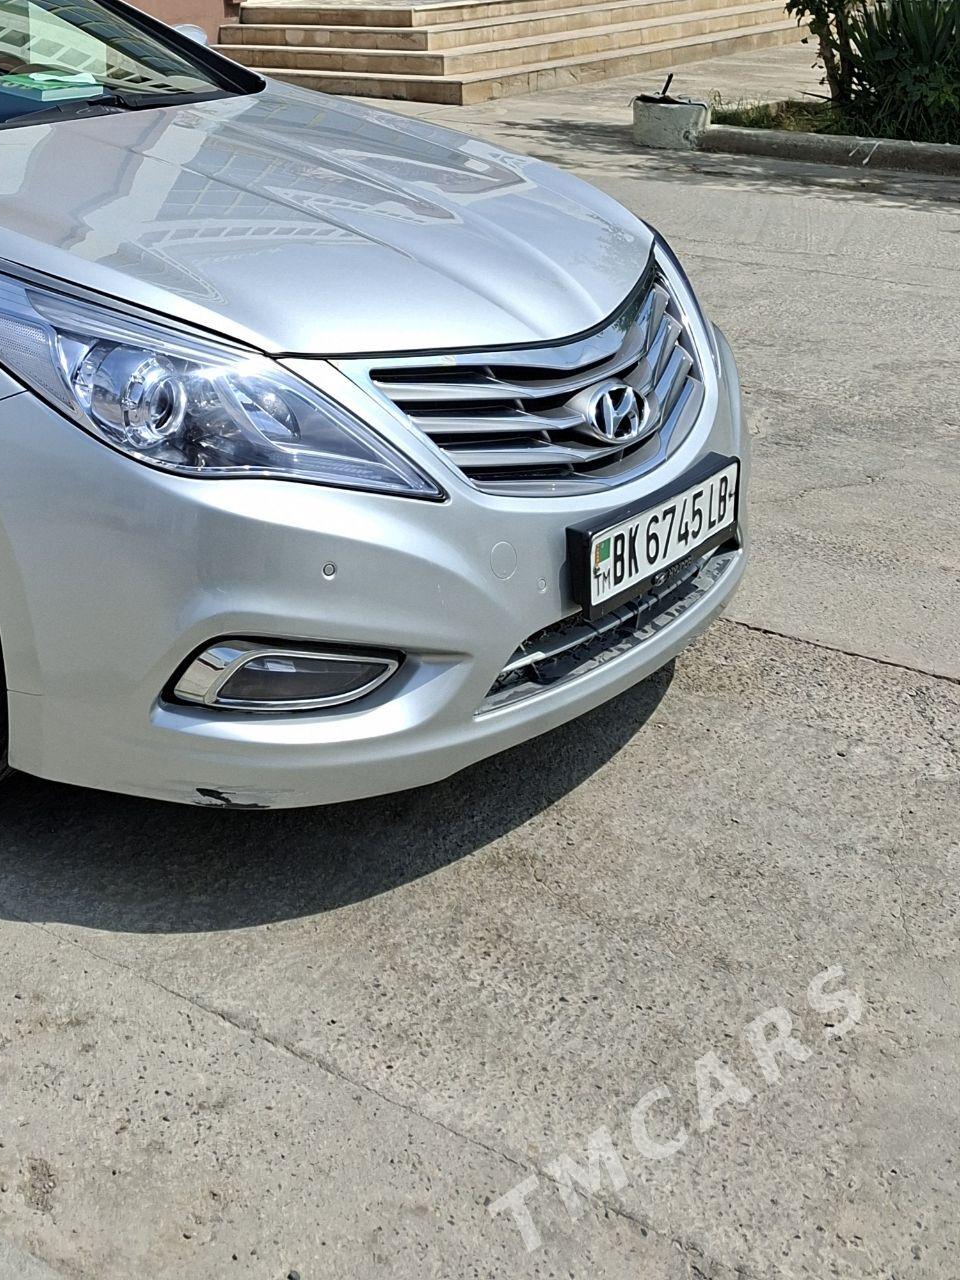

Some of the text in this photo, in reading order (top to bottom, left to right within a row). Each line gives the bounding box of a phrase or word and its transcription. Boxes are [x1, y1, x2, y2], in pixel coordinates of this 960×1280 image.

[593, 571, 611, 597] TM
[613, 523, 639, 586] BK
[646, 489, 704, 566] 6745
[707, 475, 729, 527] LB
